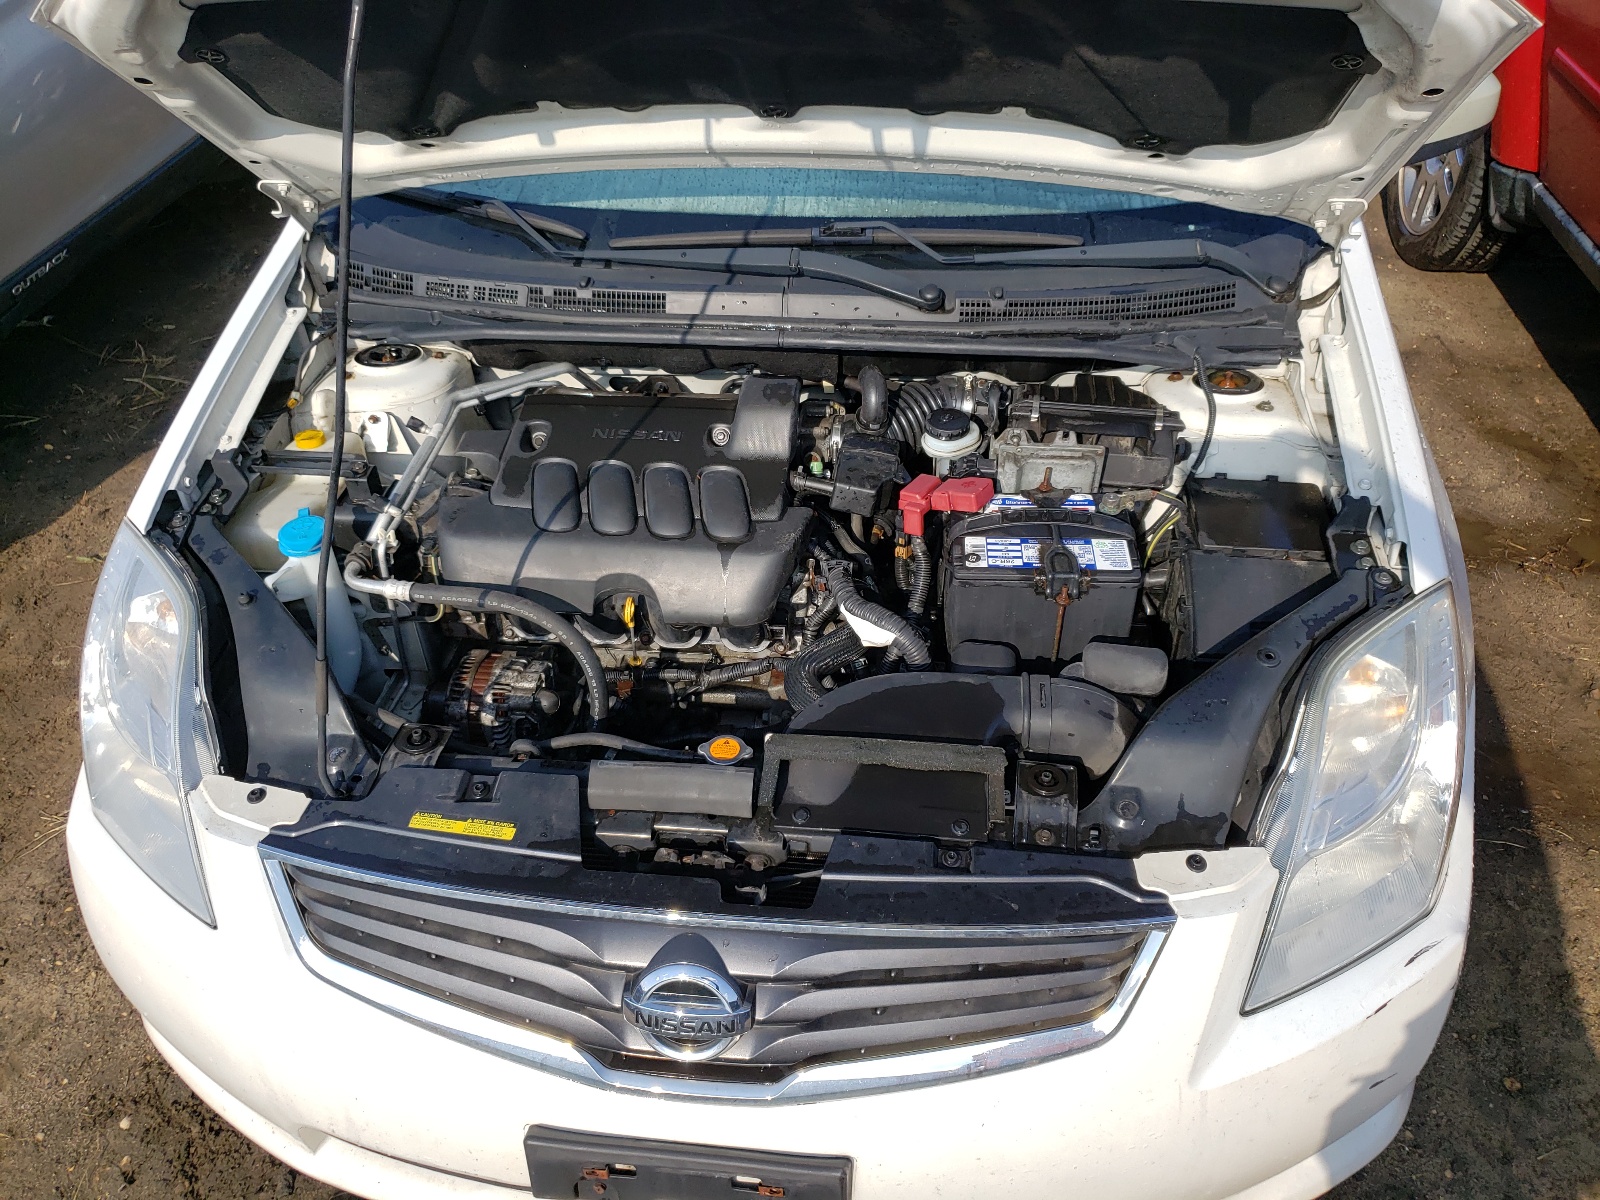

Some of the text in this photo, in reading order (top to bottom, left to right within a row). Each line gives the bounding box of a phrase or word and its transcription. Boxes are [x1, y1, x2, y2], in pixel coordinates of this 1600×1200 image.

[12, 248, 69, 296] OUTBACK
[591, 428, 684, 442] NISSAN
[635, 1010, 737, 1036] NISSAN
